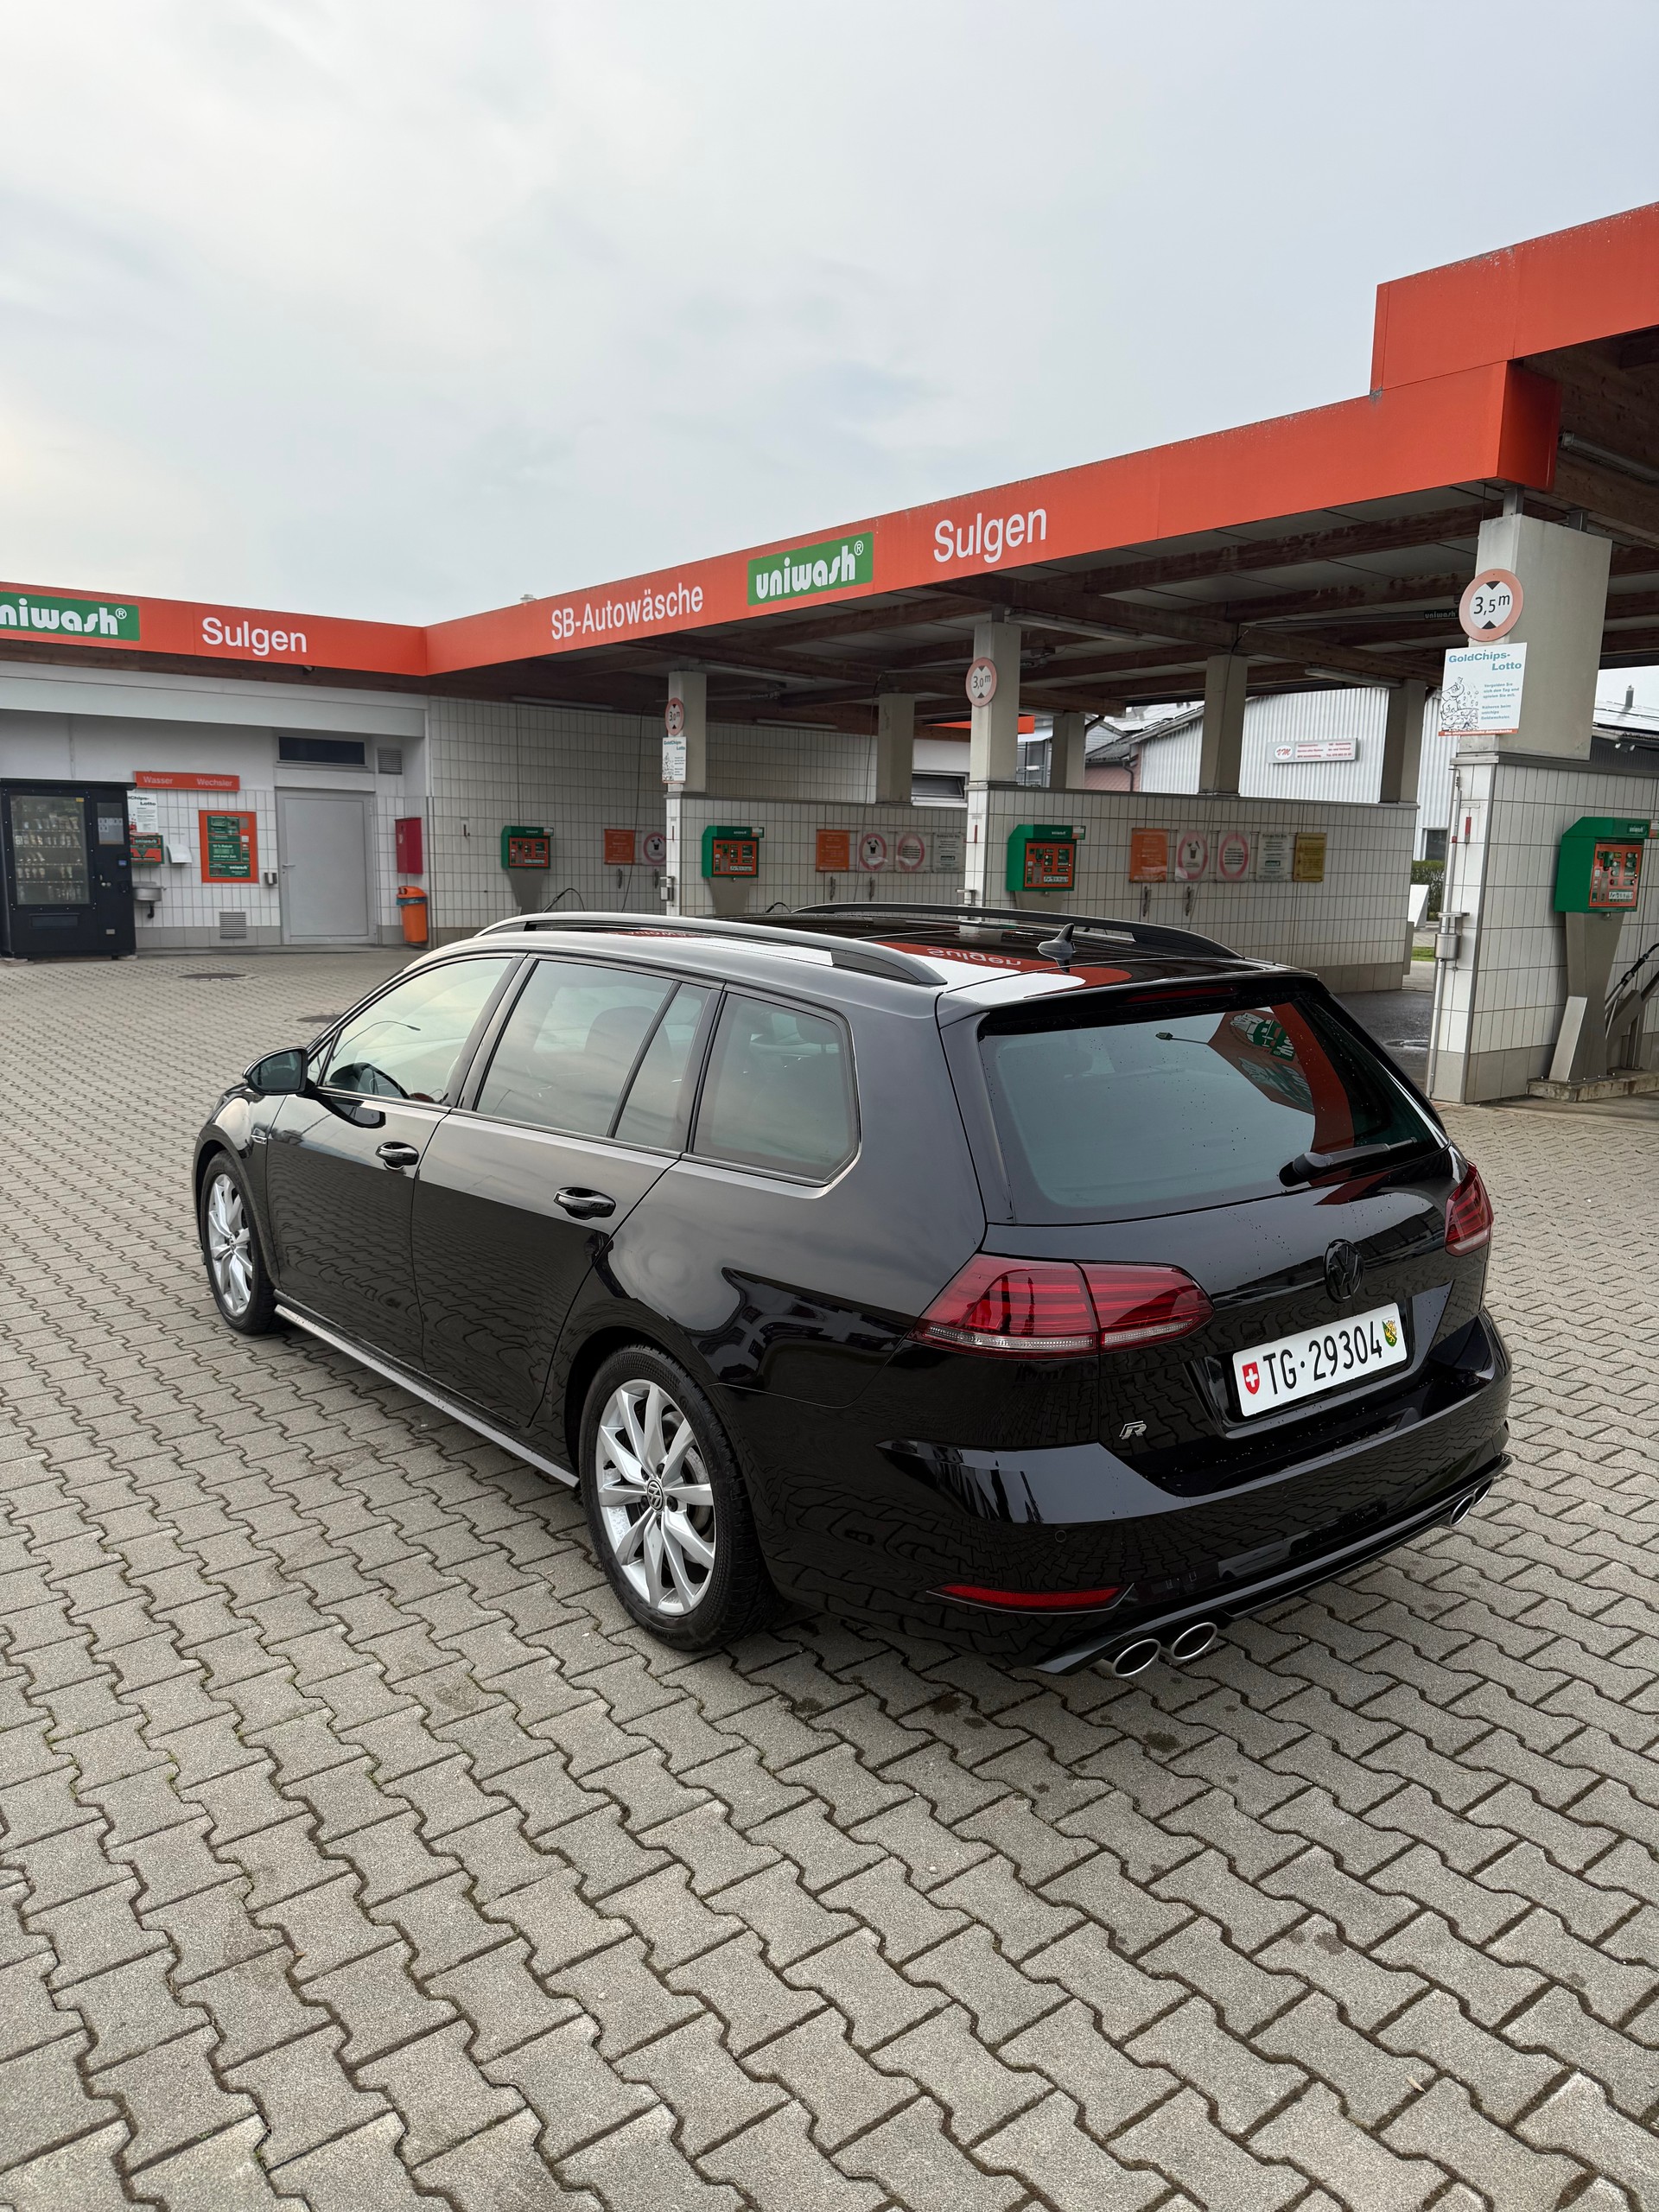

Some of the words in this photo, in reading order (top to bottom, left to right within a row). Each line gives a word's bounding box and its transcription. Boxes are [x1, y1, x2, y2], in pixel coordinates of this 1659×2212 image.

[933, 508, 1046, 563] Sulgen
[0, 597, 127, 635] niwash®
[551, 582, 703, 640] SB-Autowäsche
[201, 617, 307, 656] Sulgen
[1448, 652, 1510, 663] GoldChips-
[1491, 662, 1522, 671] Lotto
[143, 776, 174, 785] Wasser
[1119, 1421, 1147, 1440] R
